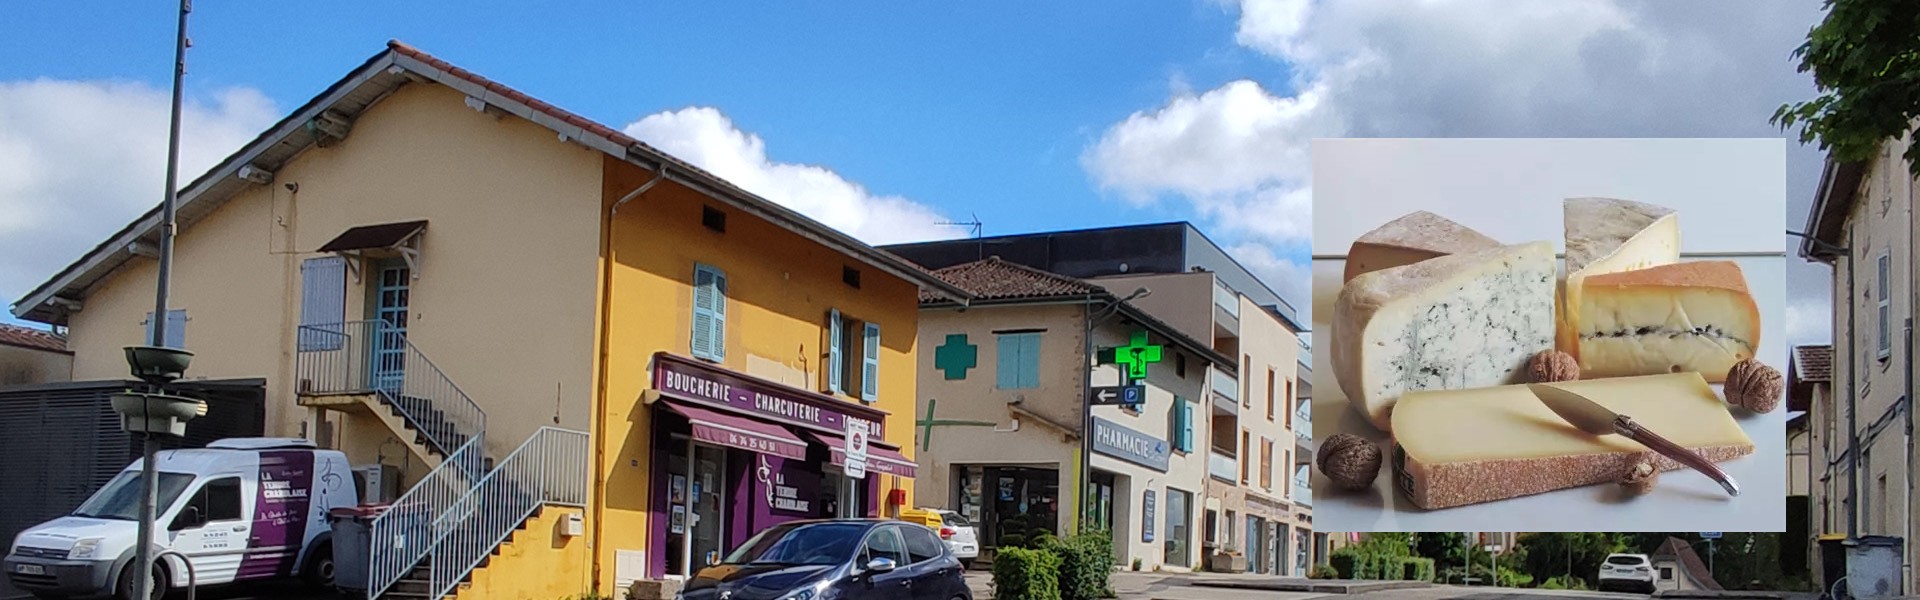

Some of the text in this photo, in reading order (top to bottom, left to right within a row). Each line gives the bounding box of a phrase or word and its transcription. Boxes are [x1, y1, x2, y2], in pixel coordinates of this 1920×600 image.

[666, 370, 731, 402] BOUCHERIE
[755, 392, 820, 423] CHARCUTERIE
[1096, 425, 1149, 458] PHARMACIE
[776, 472, 785, 485] LA
